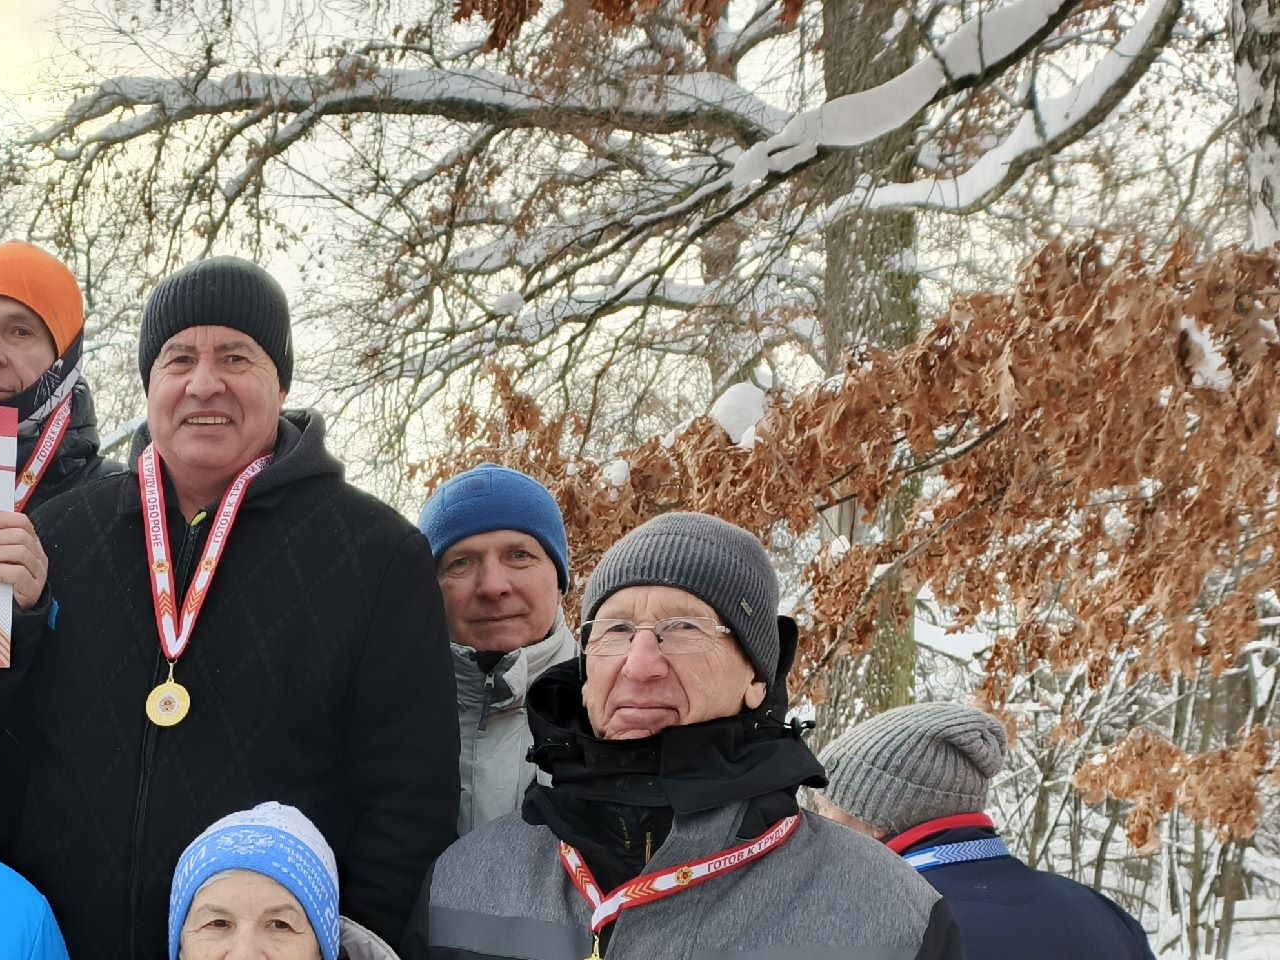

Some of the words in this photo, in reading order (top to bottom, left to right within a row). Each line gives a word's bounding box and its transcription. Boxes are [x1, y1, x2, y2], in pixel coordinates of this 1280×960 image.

[37, 435, 55, 462] ГОТОВ
[148, 497, 163, 547] ОБОРОНЕ
[213, 511, 231, 544] ГОТОВ
[707, 852, 744, 873] ГОТОВ
[747, 845, 756, 857] К
